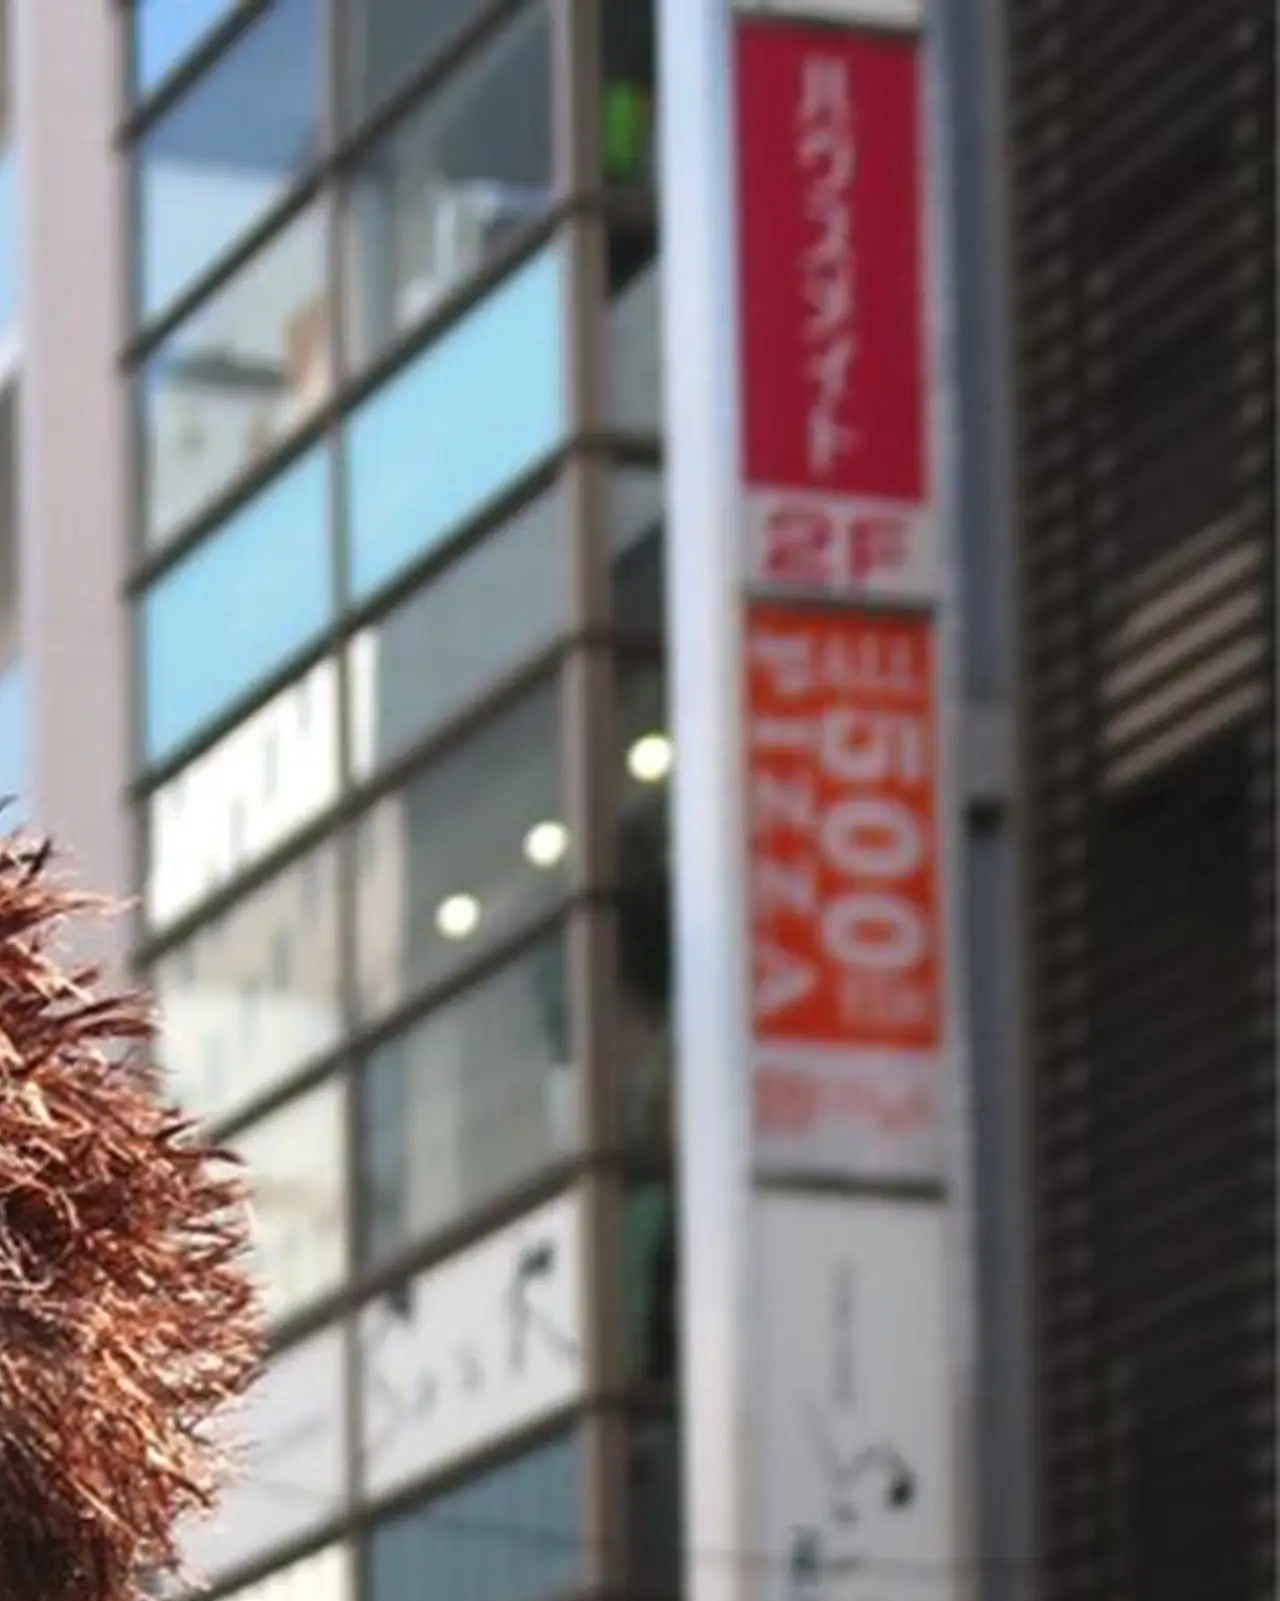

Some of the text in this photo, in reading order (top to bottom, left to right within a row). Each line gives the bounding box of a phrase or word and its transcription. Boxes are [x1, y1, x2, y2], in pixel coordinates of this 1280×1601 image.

[760, 510, 908, 585] 2F
[753, 632, 822, 1014] PIZZA
[819, 706, 925, 976] 500
